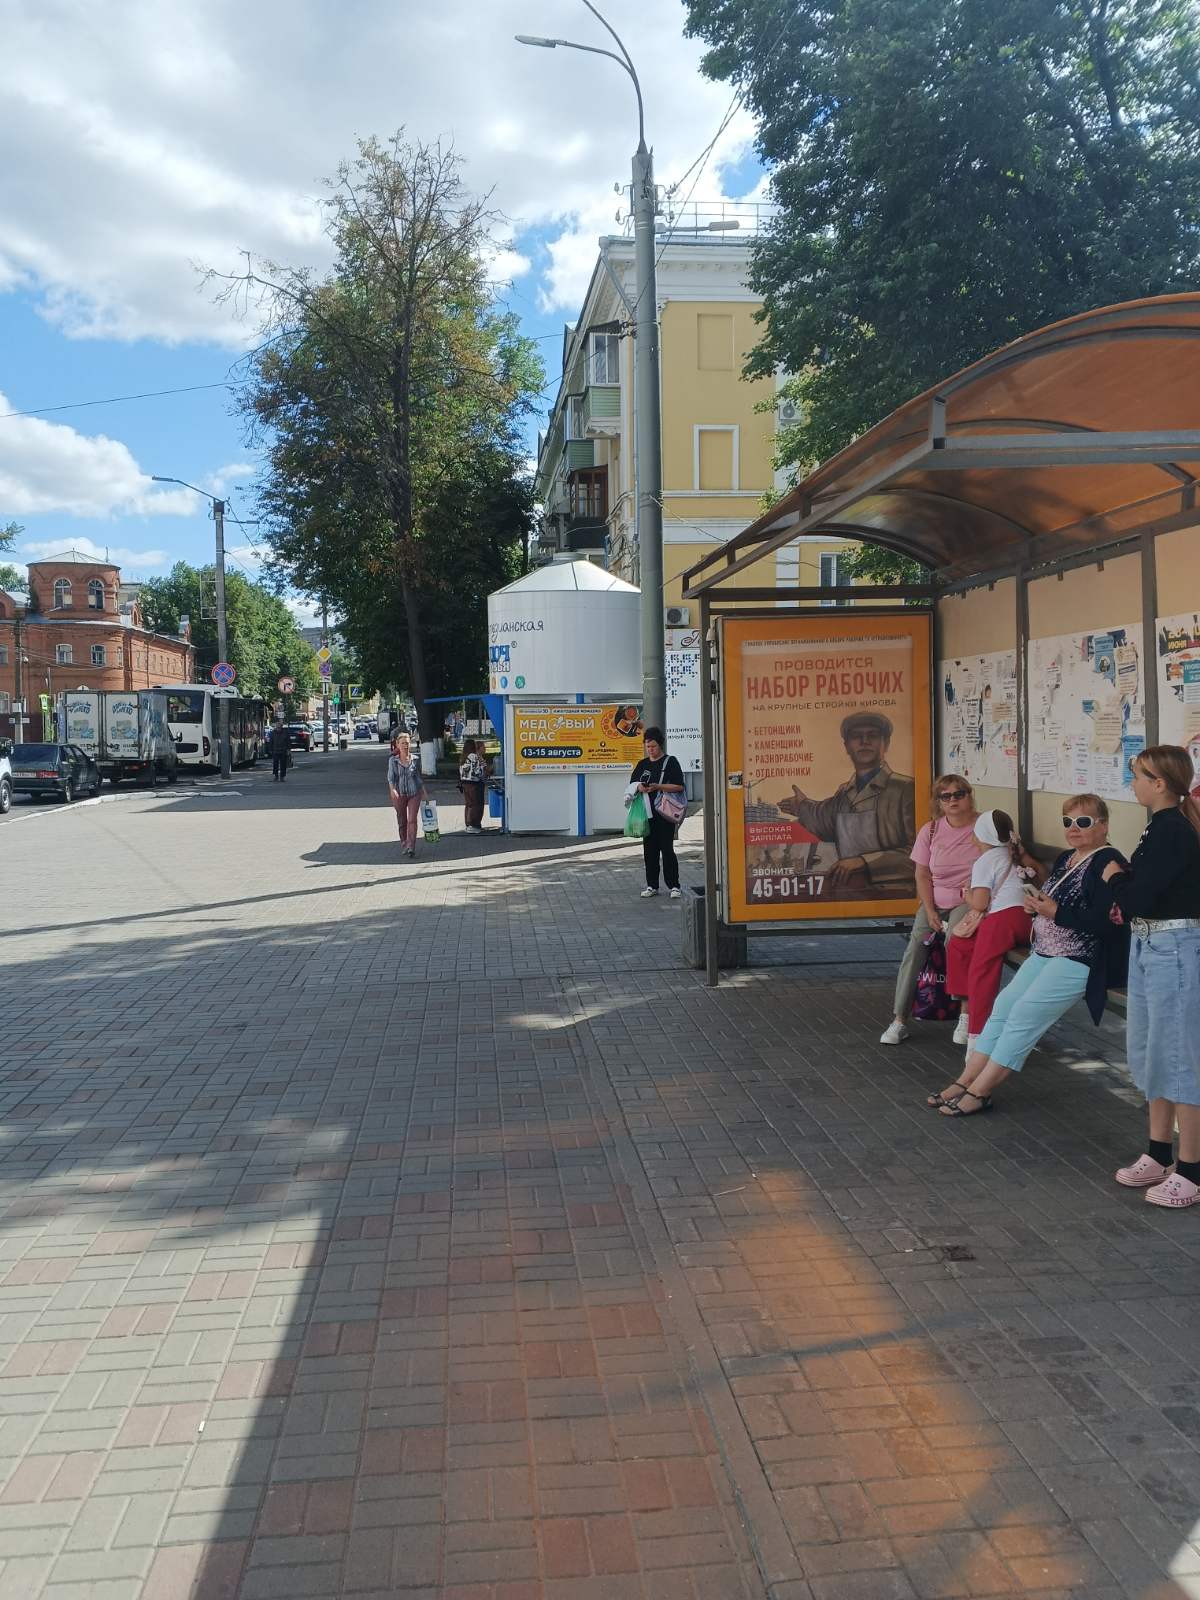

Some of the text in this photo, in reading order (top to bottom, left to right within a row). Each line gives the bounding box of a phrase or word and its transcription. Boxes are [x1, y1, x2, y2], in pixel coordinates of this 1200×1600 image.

[774, 657, 873, 672] ПРОВОДИТСЯ
[747, 671, 904, 700] НАБОР РАБОЧИХ
[752, 699, 897, 712] НА КРУПНЫЕ СТРОЙКИ КИРОВА
[754, 724, 801, 736] БЕТОНЩИКИ
[519, 732, 556, 742] СПАС
[754, 739, 804, 750] КАМЕНЩИКИ
[522, 748, 546, 756] 13-15
[547, 749, 581, 758] августа
[755, 752, 814, 764] РАЗНОРАБОЧИЕ
[755, 767, 811, 778] ОТДЕЛОЧНИКИ
[750, 825, 792, 834] ВЫСОКАЯ
[750, 834, 792, 842] ЗАРПЛАТА
[752, 867, 795, 876] ЗВОНИТЕ
[752, 876, 824, 898] 45-01-17
